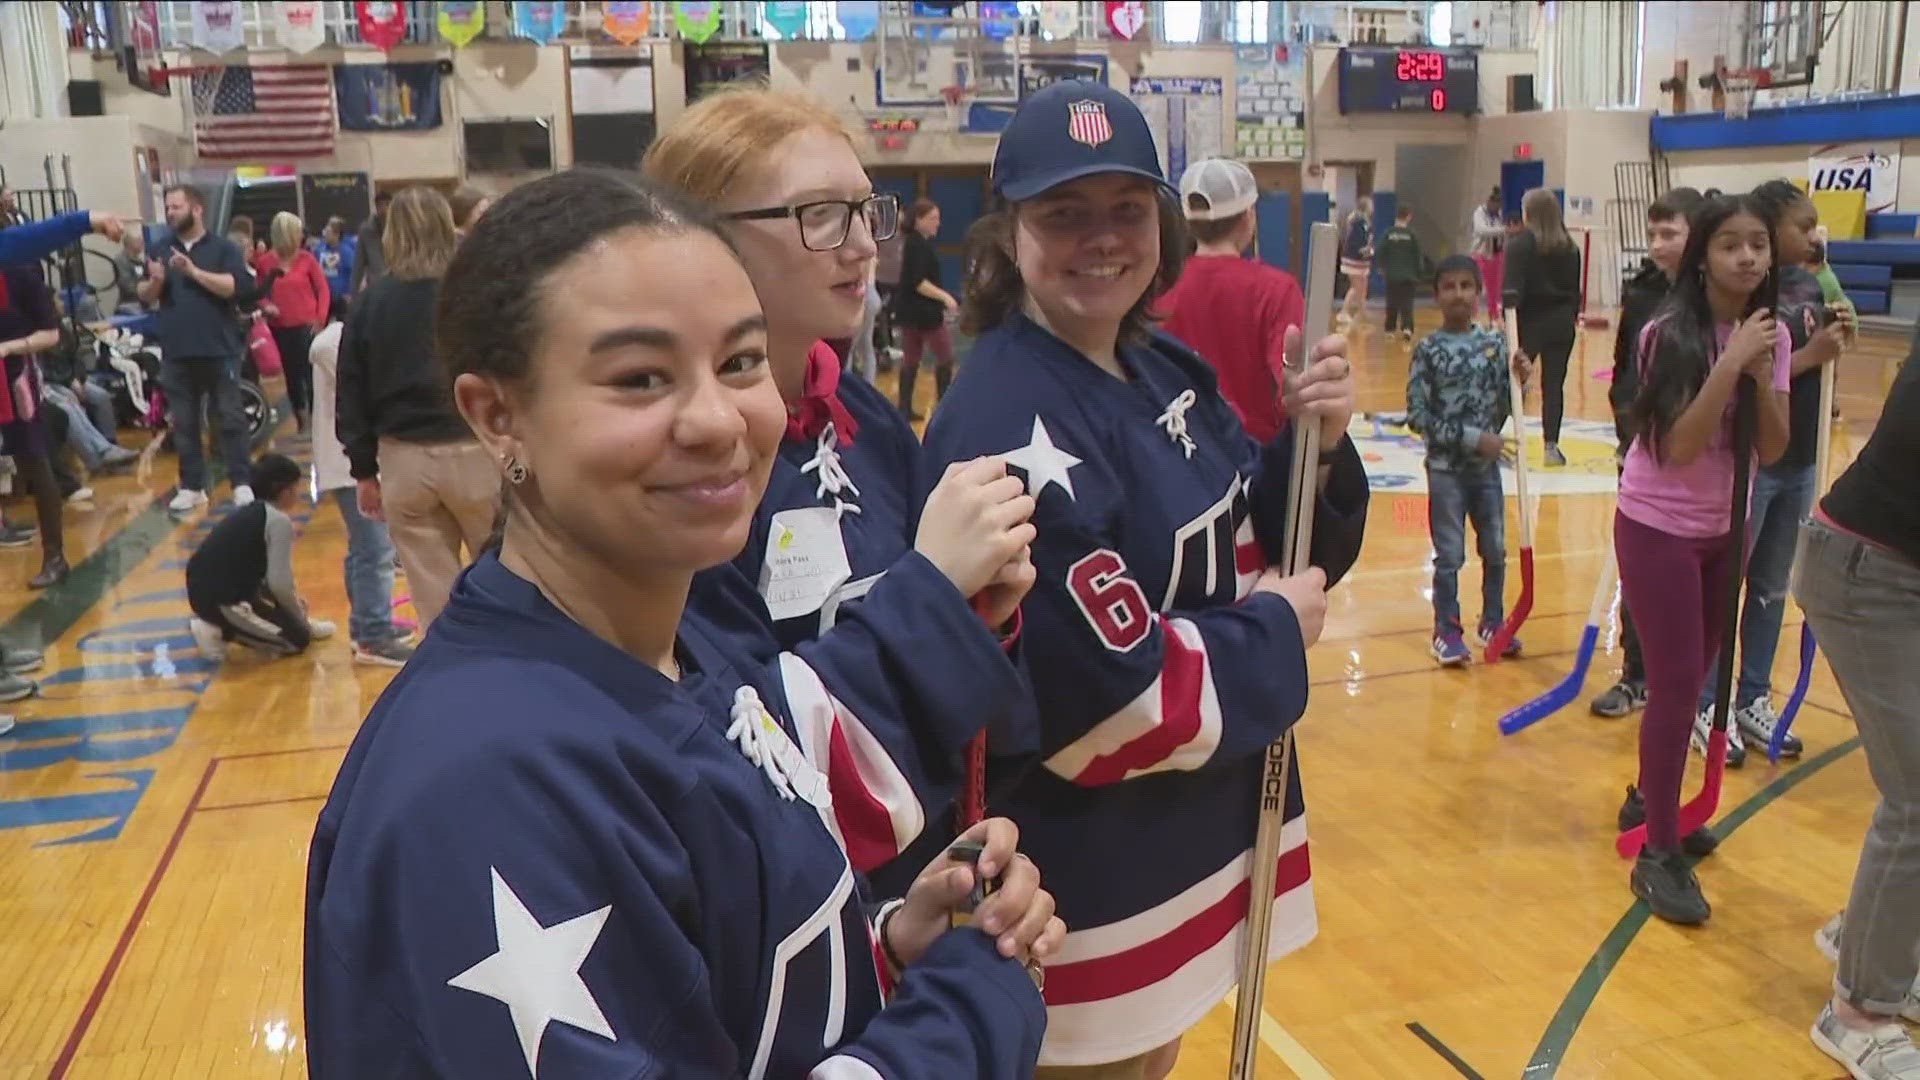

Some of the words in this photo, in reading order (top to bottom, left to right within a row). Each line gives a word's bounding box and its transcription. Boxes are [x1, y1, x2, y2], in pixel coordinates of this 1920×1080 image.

[1397, 51, 1443, 80] 2:29
[1075, 103, 1099, 113] USA
[1431, 88, 1445, 111] 0
[1814, 167, 1872, 193] USA
[1065, 547, 1152, 653] 6
[1264, 731, 1286, 812] ORCE
